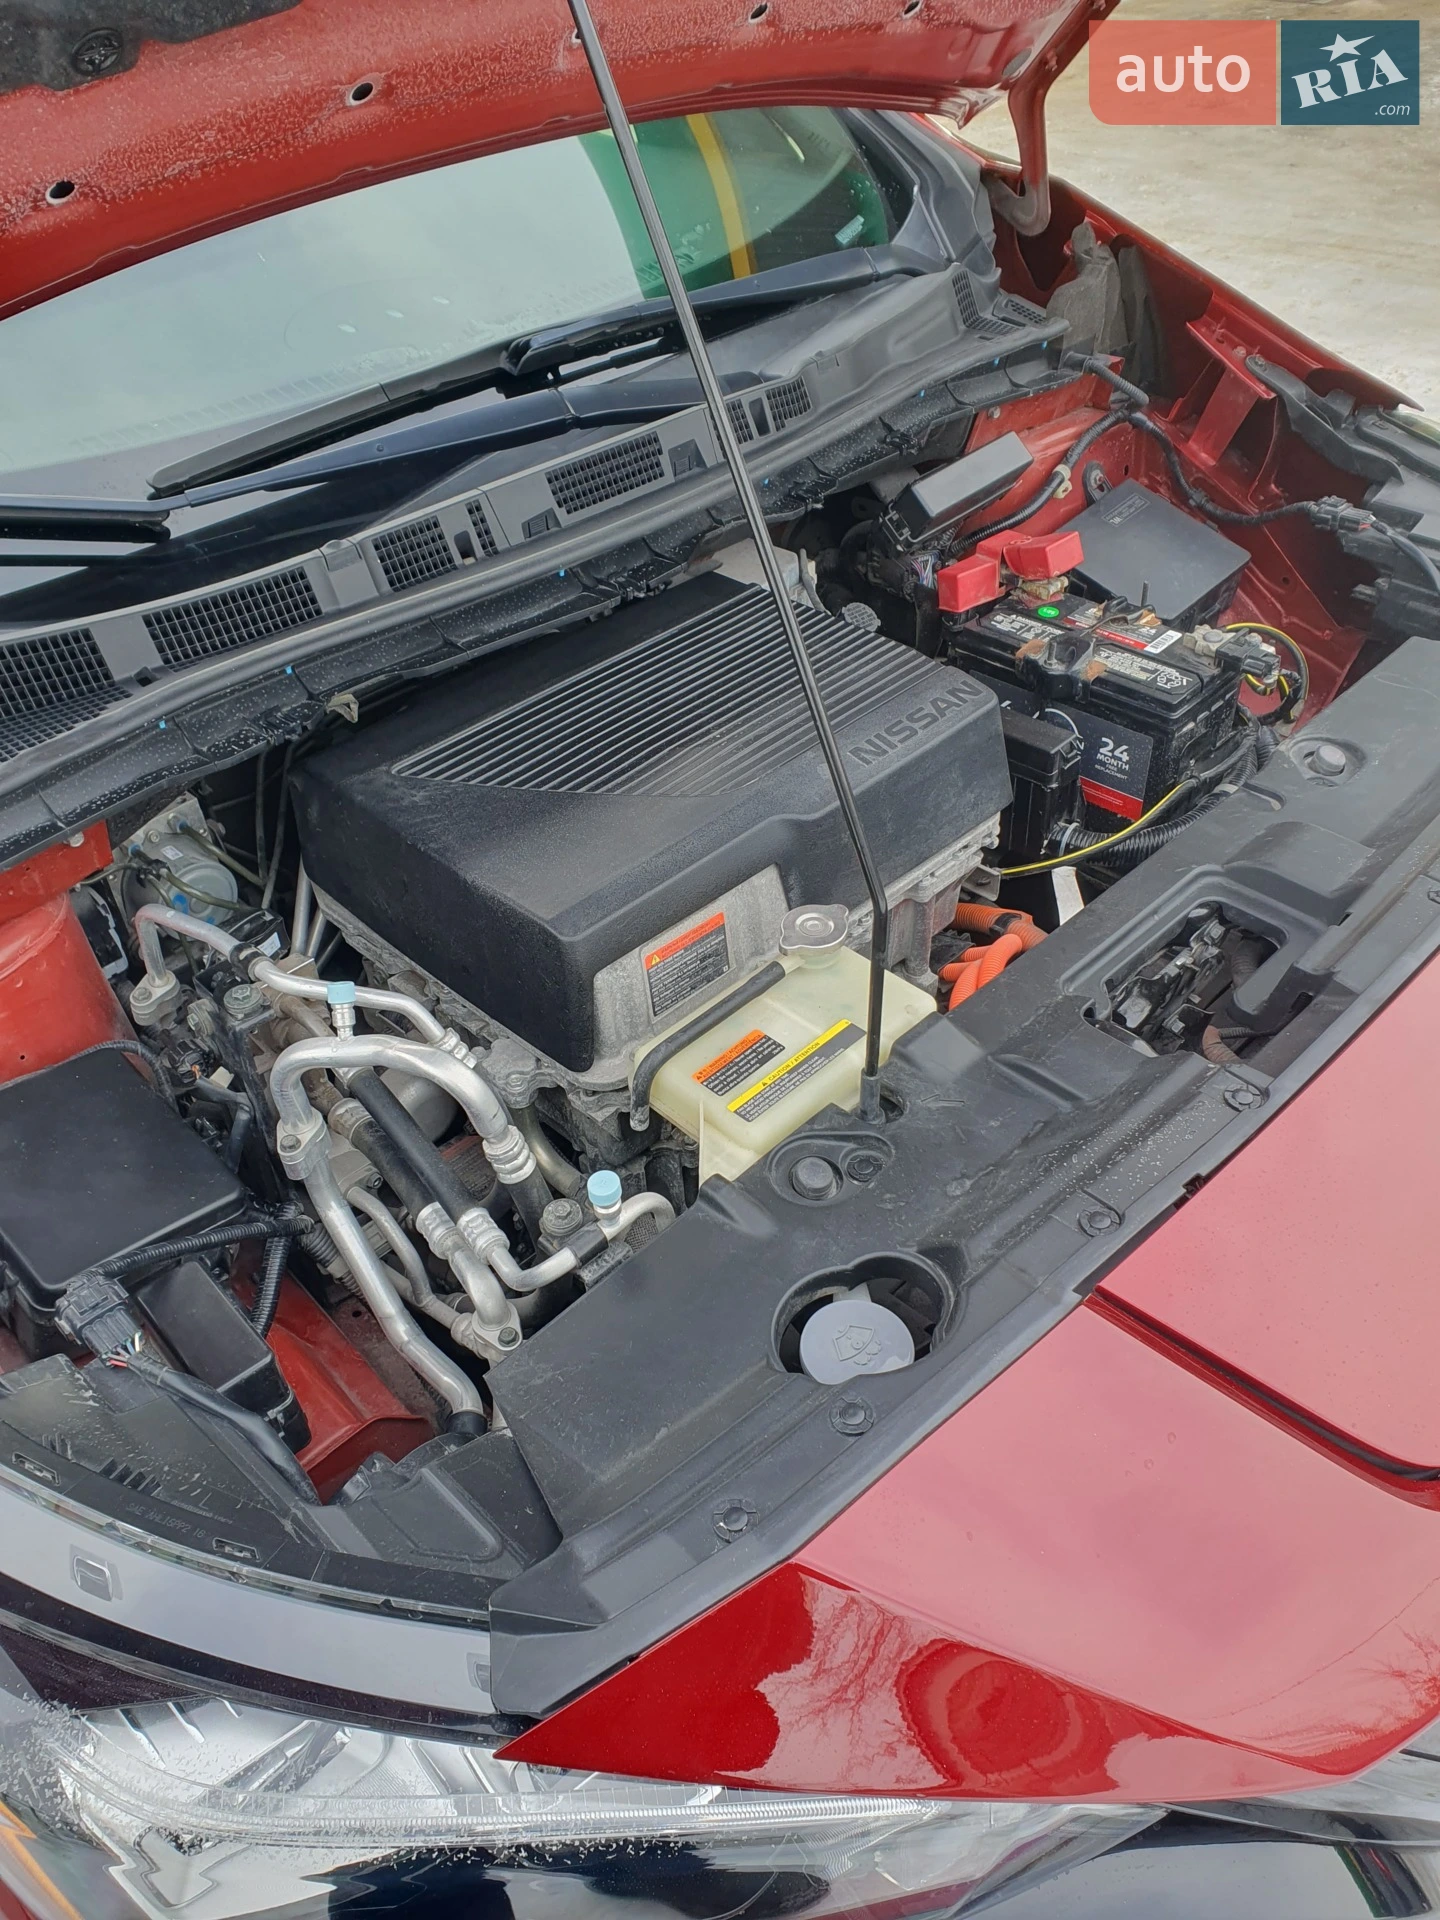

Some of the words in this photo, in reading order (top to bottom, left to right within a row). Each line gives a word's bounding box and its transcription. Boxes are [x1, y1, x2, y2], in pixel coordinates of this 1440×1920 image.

[847, 679, 983, 768] NISSAN
[1096, 753, 1129, 771] MONTH
[1099, 737, 1129, 762] 24
[767, 1063, 790, 1080] CAUTION
[793, 1041, 820, 1061] ATTENTION
